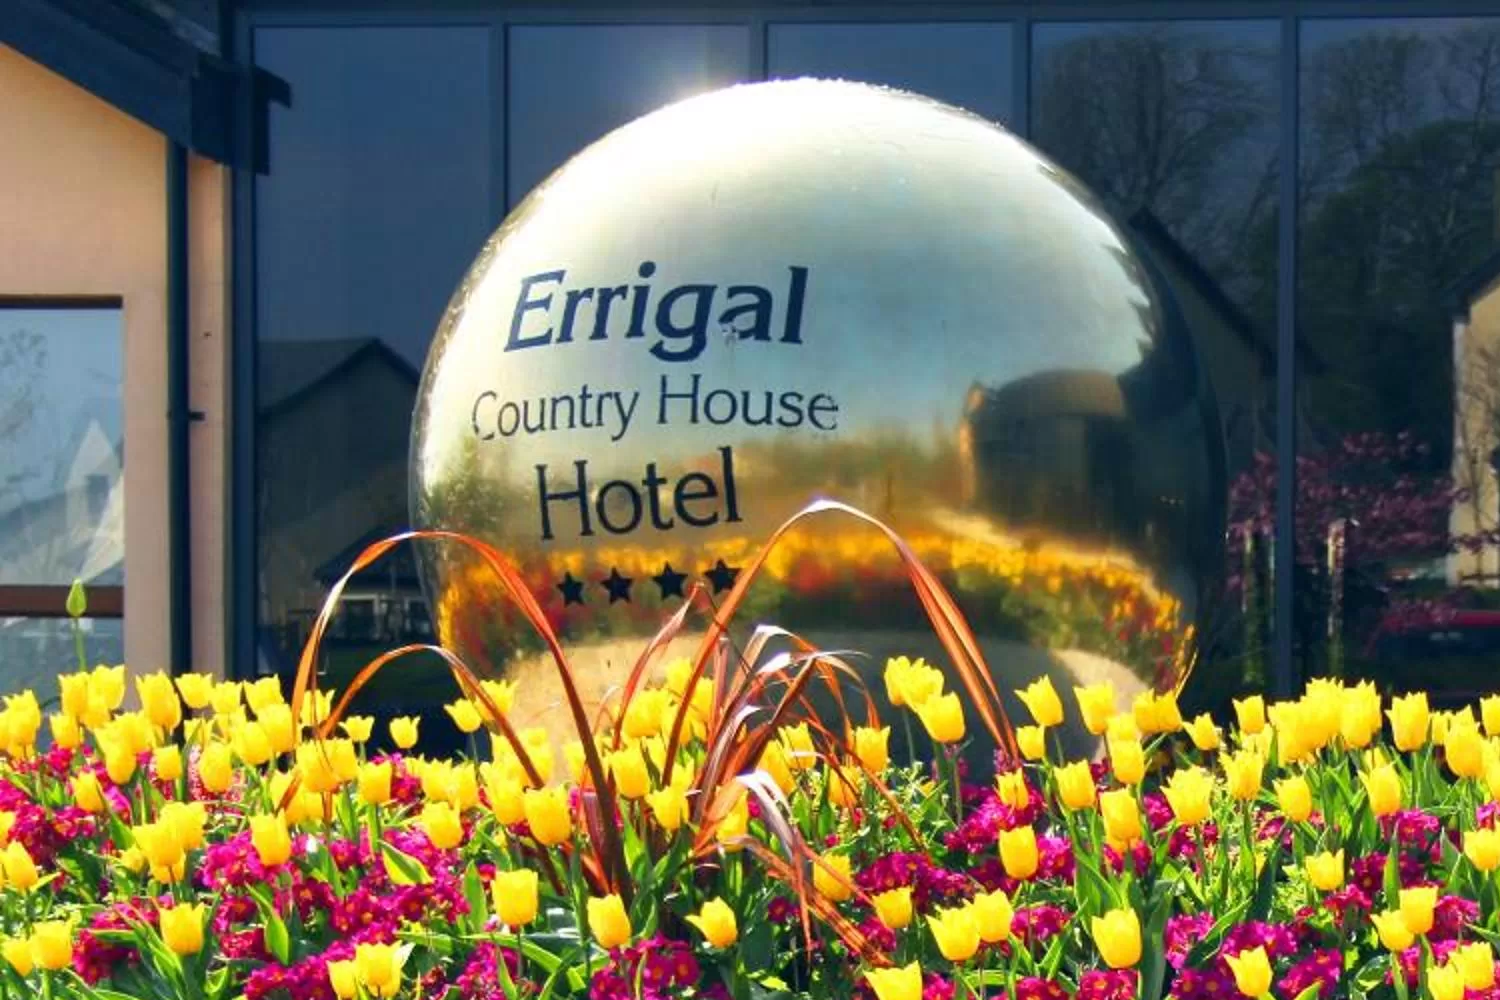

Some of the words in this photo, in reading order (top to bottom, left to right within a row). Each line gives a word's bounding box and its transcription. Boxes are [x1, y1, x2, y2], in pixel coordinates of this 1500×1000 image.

[504, 261, 809, 362] Errigal
[472, 383, 640, 442] Country
[657, 374, 840, 430] House
[534, 446, 743, 540] Hotel
